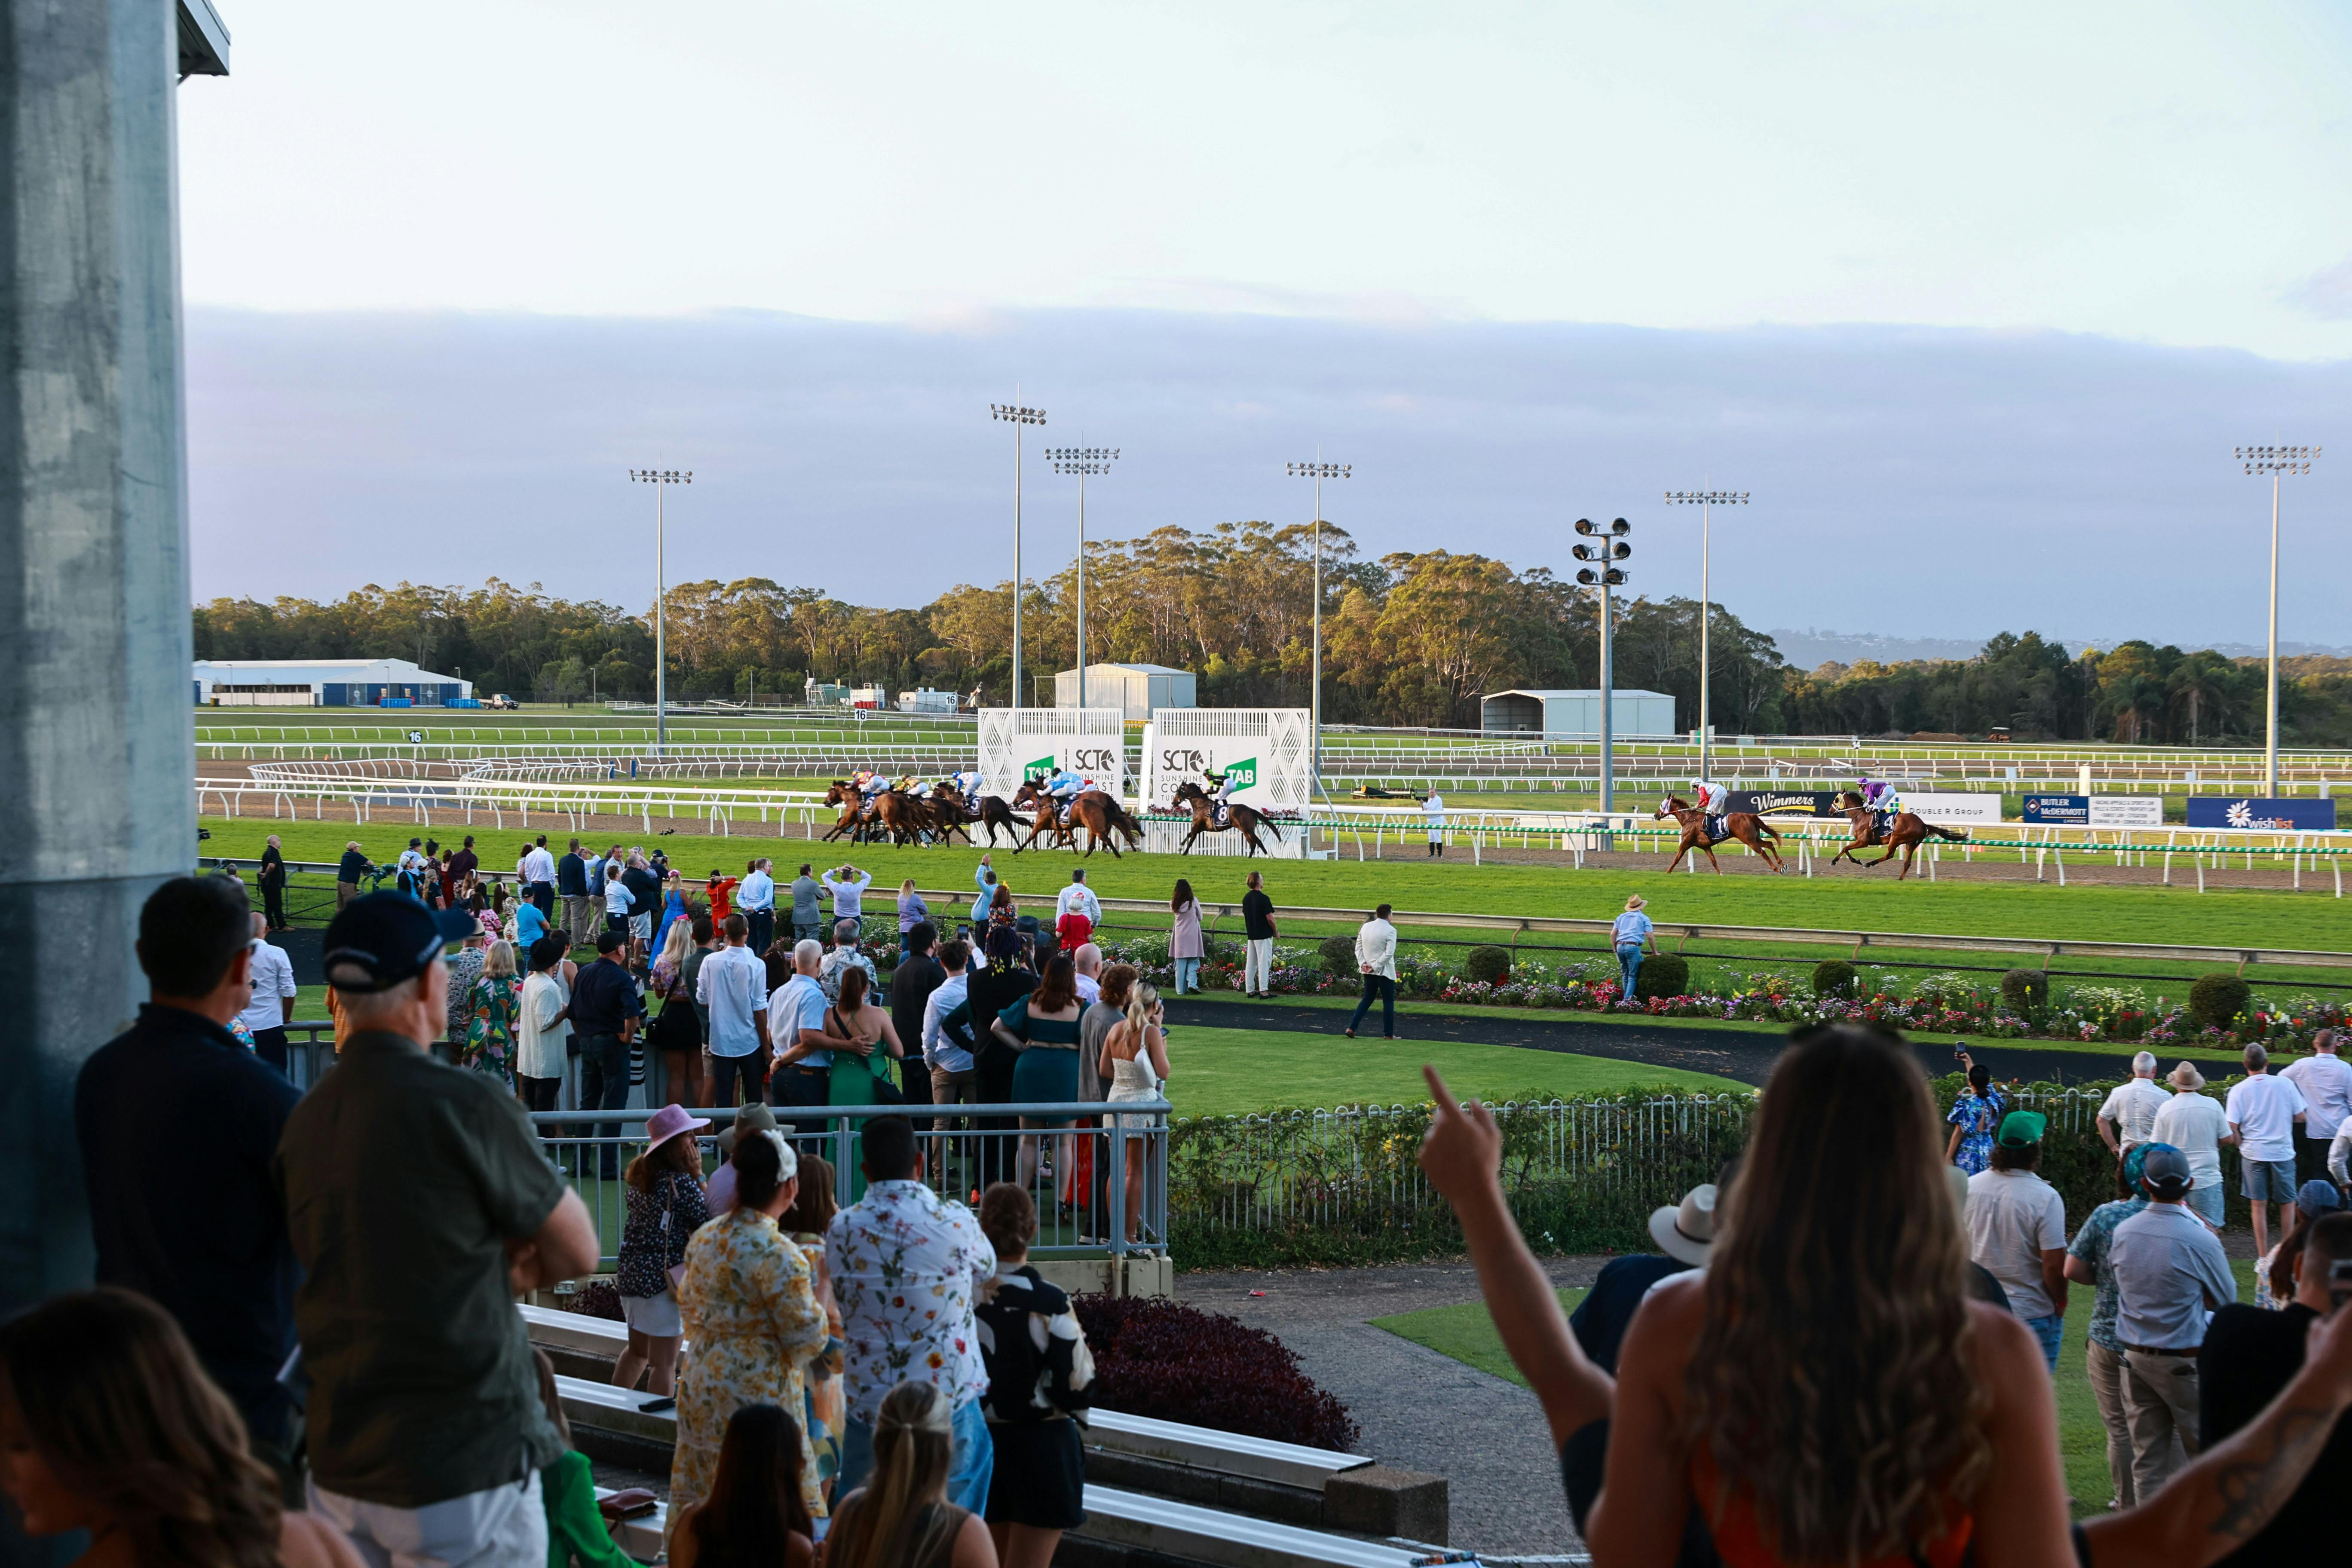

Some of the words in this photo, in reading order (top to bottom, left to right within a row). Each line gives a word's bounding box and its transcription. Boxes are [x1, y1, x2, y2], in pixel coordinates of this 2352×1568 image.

[946, 696, 955, 704] 16
[856, 710, 866, 720] 16
[409, 732, 421, 742] 16
[1227, 769, 1254, 784] TAB
[1095, 782, 1114, 791] AST
[971, 797, 981, 810] 5
[1751, 793, 1815, 811] Wimmers
[1060, 804, 1069, 819] 2
[1218, 806, 1227, 821] 8
[1716, 816, 1727, 833] 11
[1884, 815, 1893, 829] 4
[2247, 818, 2294, 829] wishlist
